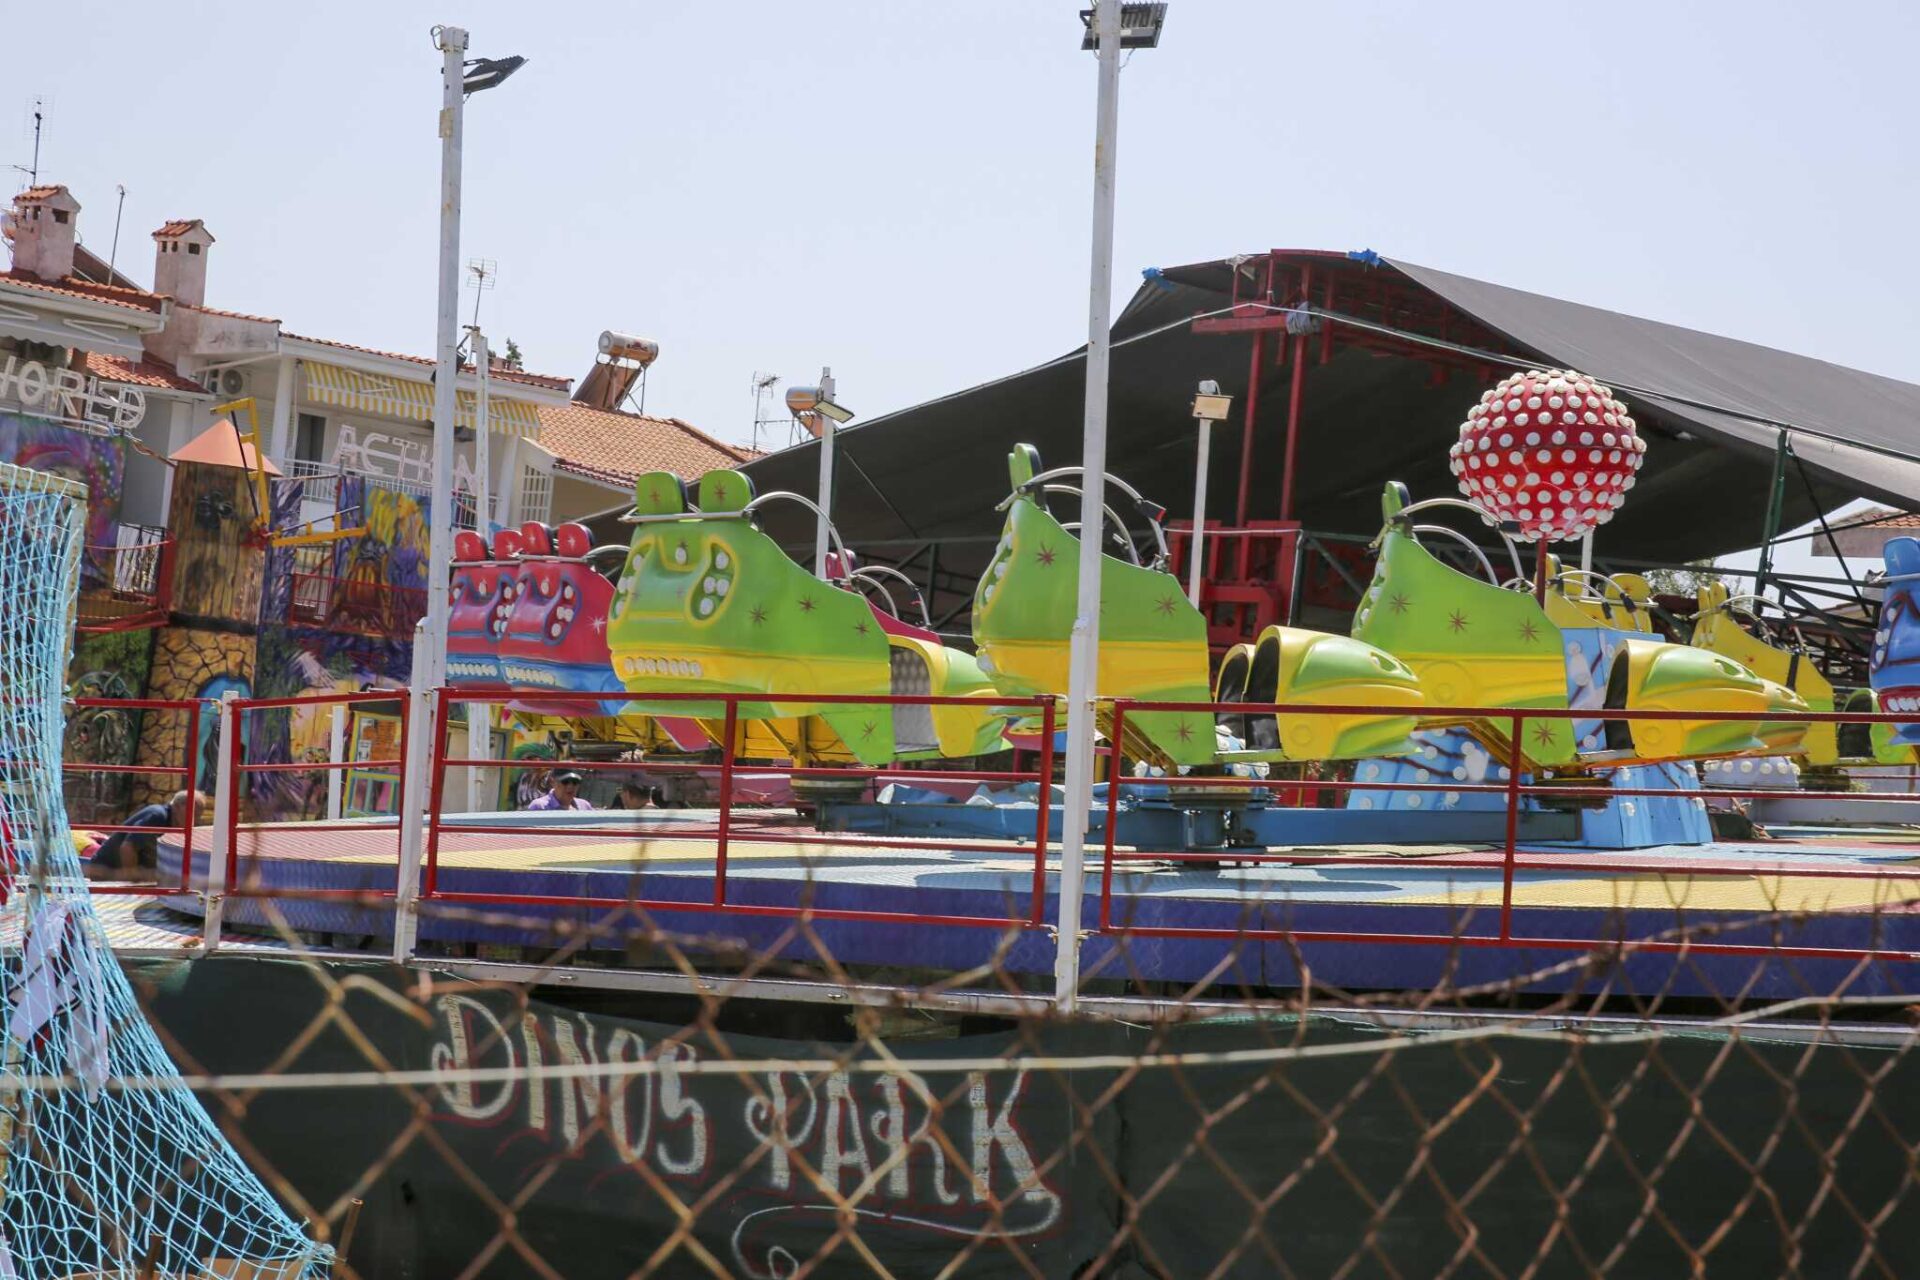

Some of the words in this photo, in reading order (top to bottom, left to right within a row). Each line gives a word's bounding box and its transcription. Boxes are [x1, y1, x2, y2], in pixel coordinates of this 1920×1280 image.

[331, 424, 480, 496] ACTIN
[430, 993, 705, 1175] DINOS
[744, 1064, 1062, 1208] PARK
